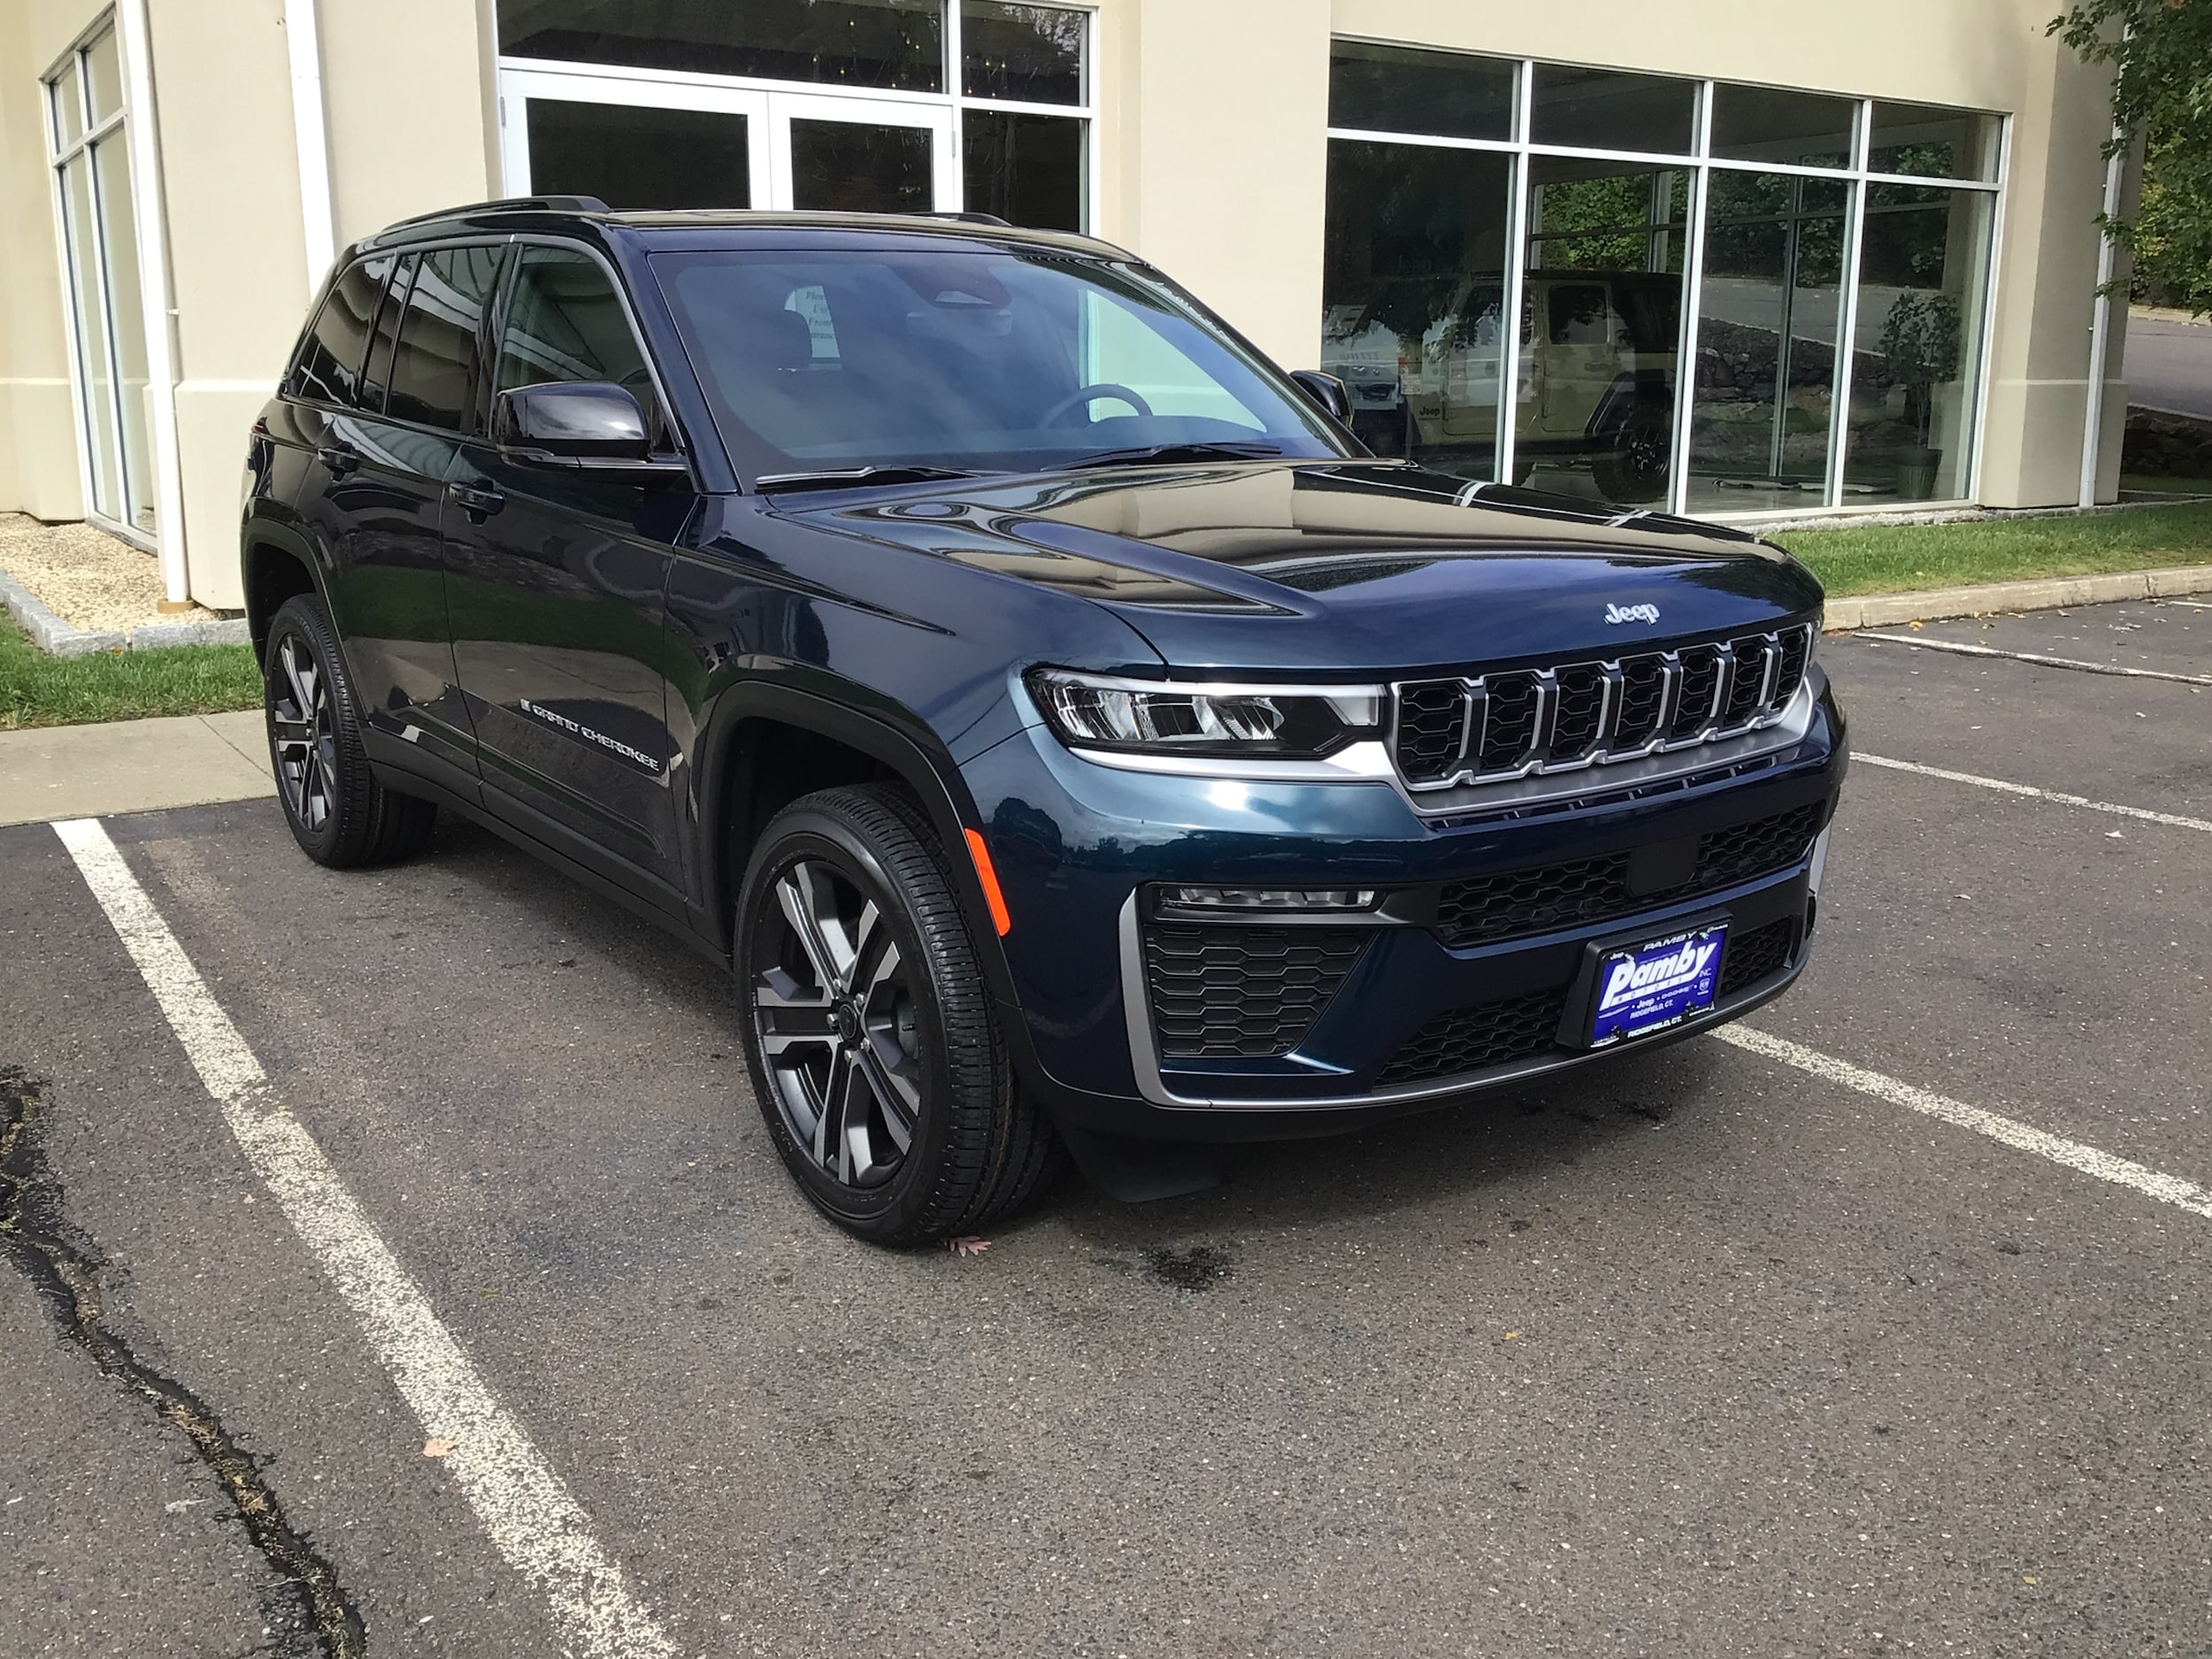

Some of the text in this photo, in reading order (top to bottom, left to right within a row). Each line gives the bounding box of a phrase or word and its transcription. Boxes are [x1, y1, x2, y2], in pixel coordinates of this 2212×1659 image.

[1419, 406, 1440, 417] Jeep
[1603, 603, 1661, 626] Jeep
[532, 704, 660, 772] GRAND CHEROKEE
[1643, 930, 1698, 952] PAMBY
[1599, 941, 1718, 1011] Pamby
[1637, 998, 1655, 1010] Jeep
